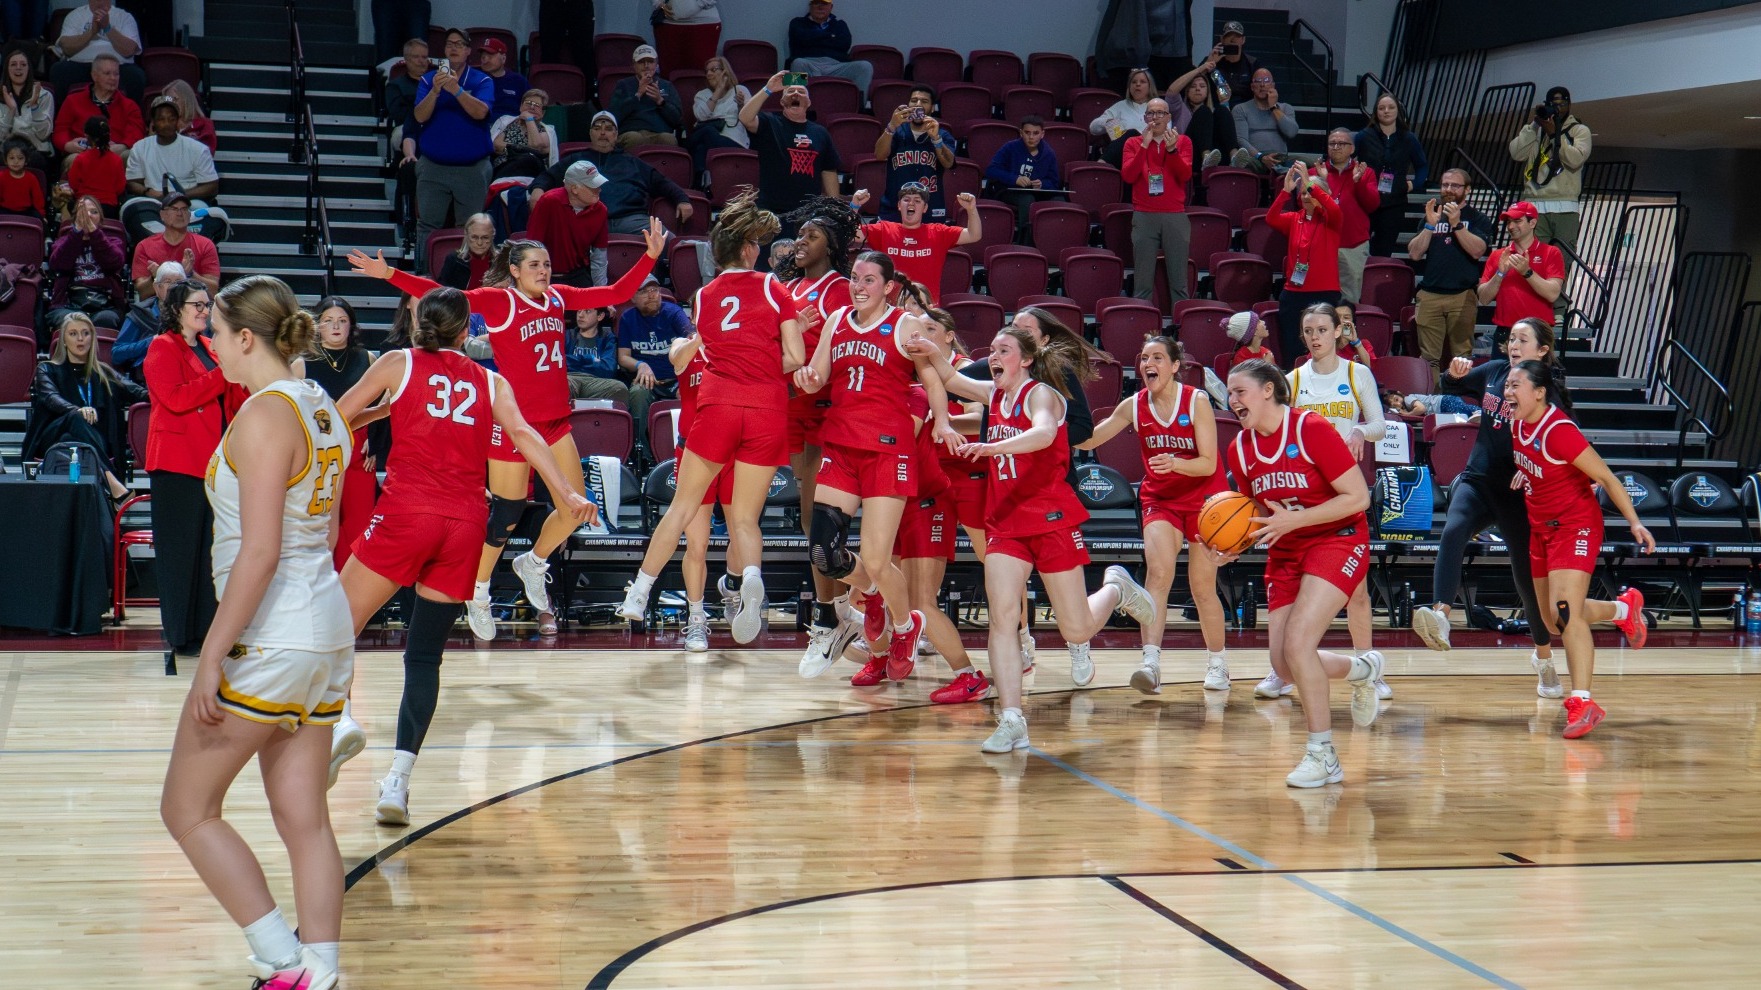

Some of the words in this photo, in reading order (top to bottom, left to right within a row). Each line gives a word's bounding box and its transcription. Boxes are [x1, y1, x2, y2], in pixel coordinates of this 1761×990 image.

[887, 247, 899, 255] GO
[900, 248, 915, 257] BIG
[916, 248, 932, 257] RED
[720, 296, 741, 332] 2
[534, 340, 564, 372] 24
[832, 340, 887, 367] DENISON
[847, 365, 865, 392] 11
[426, 374, 477, 426] 32
[491, 424, 502, 447] RED
[307, 444, 344, 517] 23
[897, 463, 909, 482] BIG
[993, 453, 1018, 481] 21
[931, 525, 943, 543] BIG
[1575, 539, 1588, 557] BIG
[1341, 555, 1360, 578] BIG
